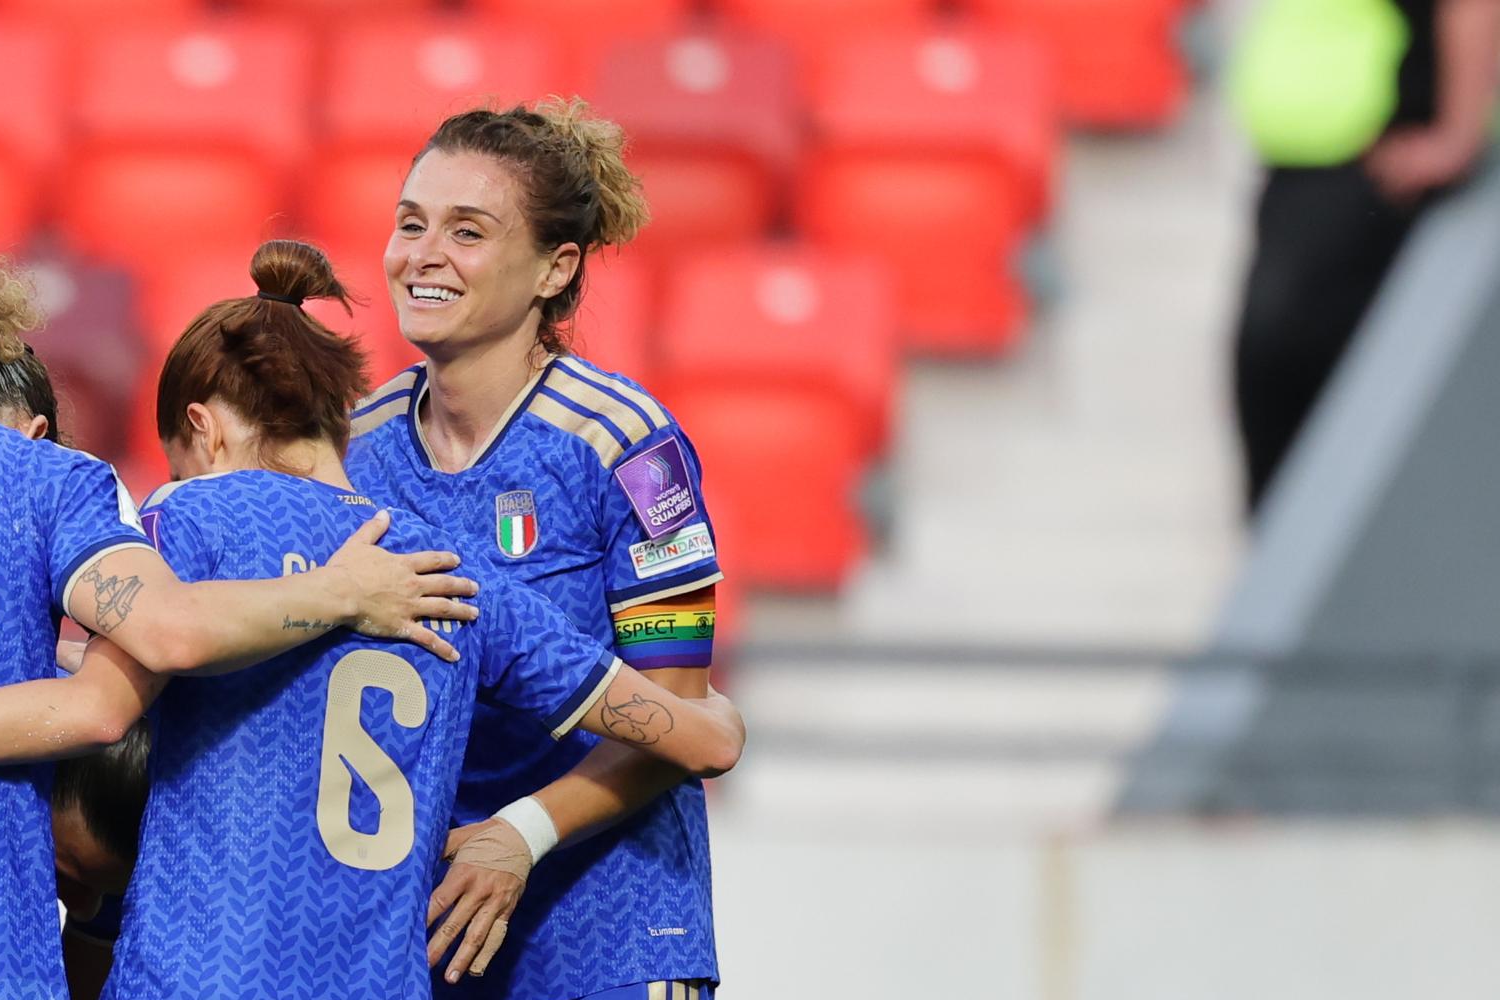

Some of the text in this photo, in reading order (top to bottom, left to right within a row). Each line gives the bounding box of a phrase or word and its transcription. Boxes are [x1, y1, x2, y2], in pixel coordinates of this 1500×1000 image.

[647, 487, 690, 518] EUROPEAN
[616, 619, 677, 640] ESPECT
[316, 649, 427, 871] 6
